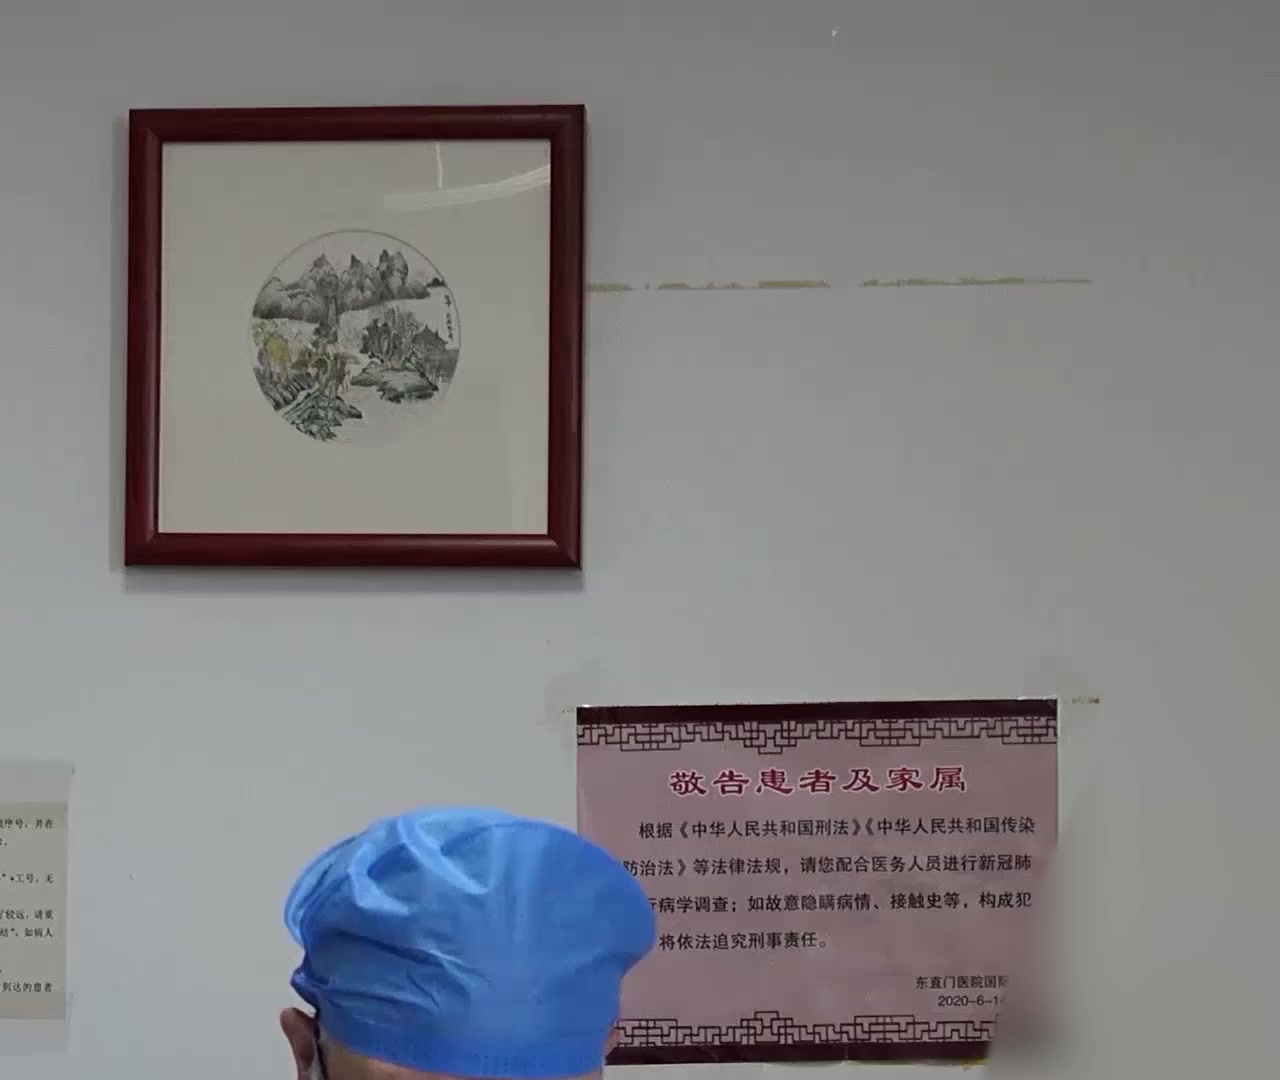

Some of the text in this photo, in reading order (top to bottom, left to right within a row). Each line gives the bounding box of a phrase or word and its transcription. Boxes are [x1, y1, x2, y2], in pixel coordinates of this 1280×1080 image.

[669, 767, 967, 795] 敬告患者及家属
[639, 817, 1035, 838] 根据《中华人民共和国刑法》《中华人民共和国传染
[659, 932, 827, 950] 将依法追究刑事责任。
